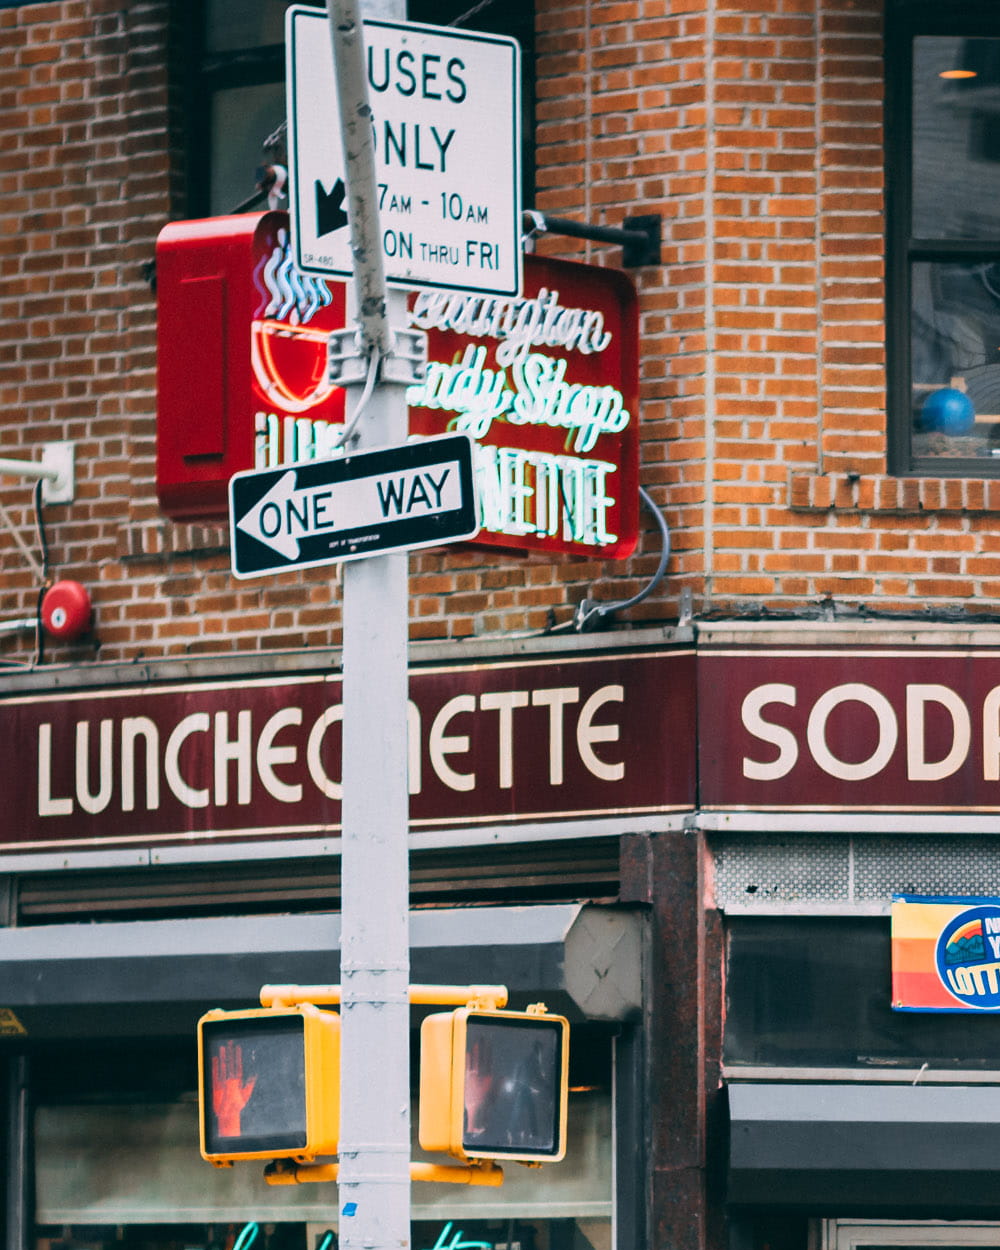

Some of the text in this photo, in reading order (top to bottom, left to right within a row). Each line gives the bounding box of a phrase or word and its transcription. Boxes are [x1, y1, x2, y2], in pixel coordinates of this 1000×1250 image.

[367, 45, 467, 104] USES
[371, 114, 456, 173] NLY
[441, 192, 488, 224] 10AM
[383, 229, 500, 270] ON THRU FRI
[506, 352, 630, 453] Shop
[258, 467, 452, 540] ONE WAY
